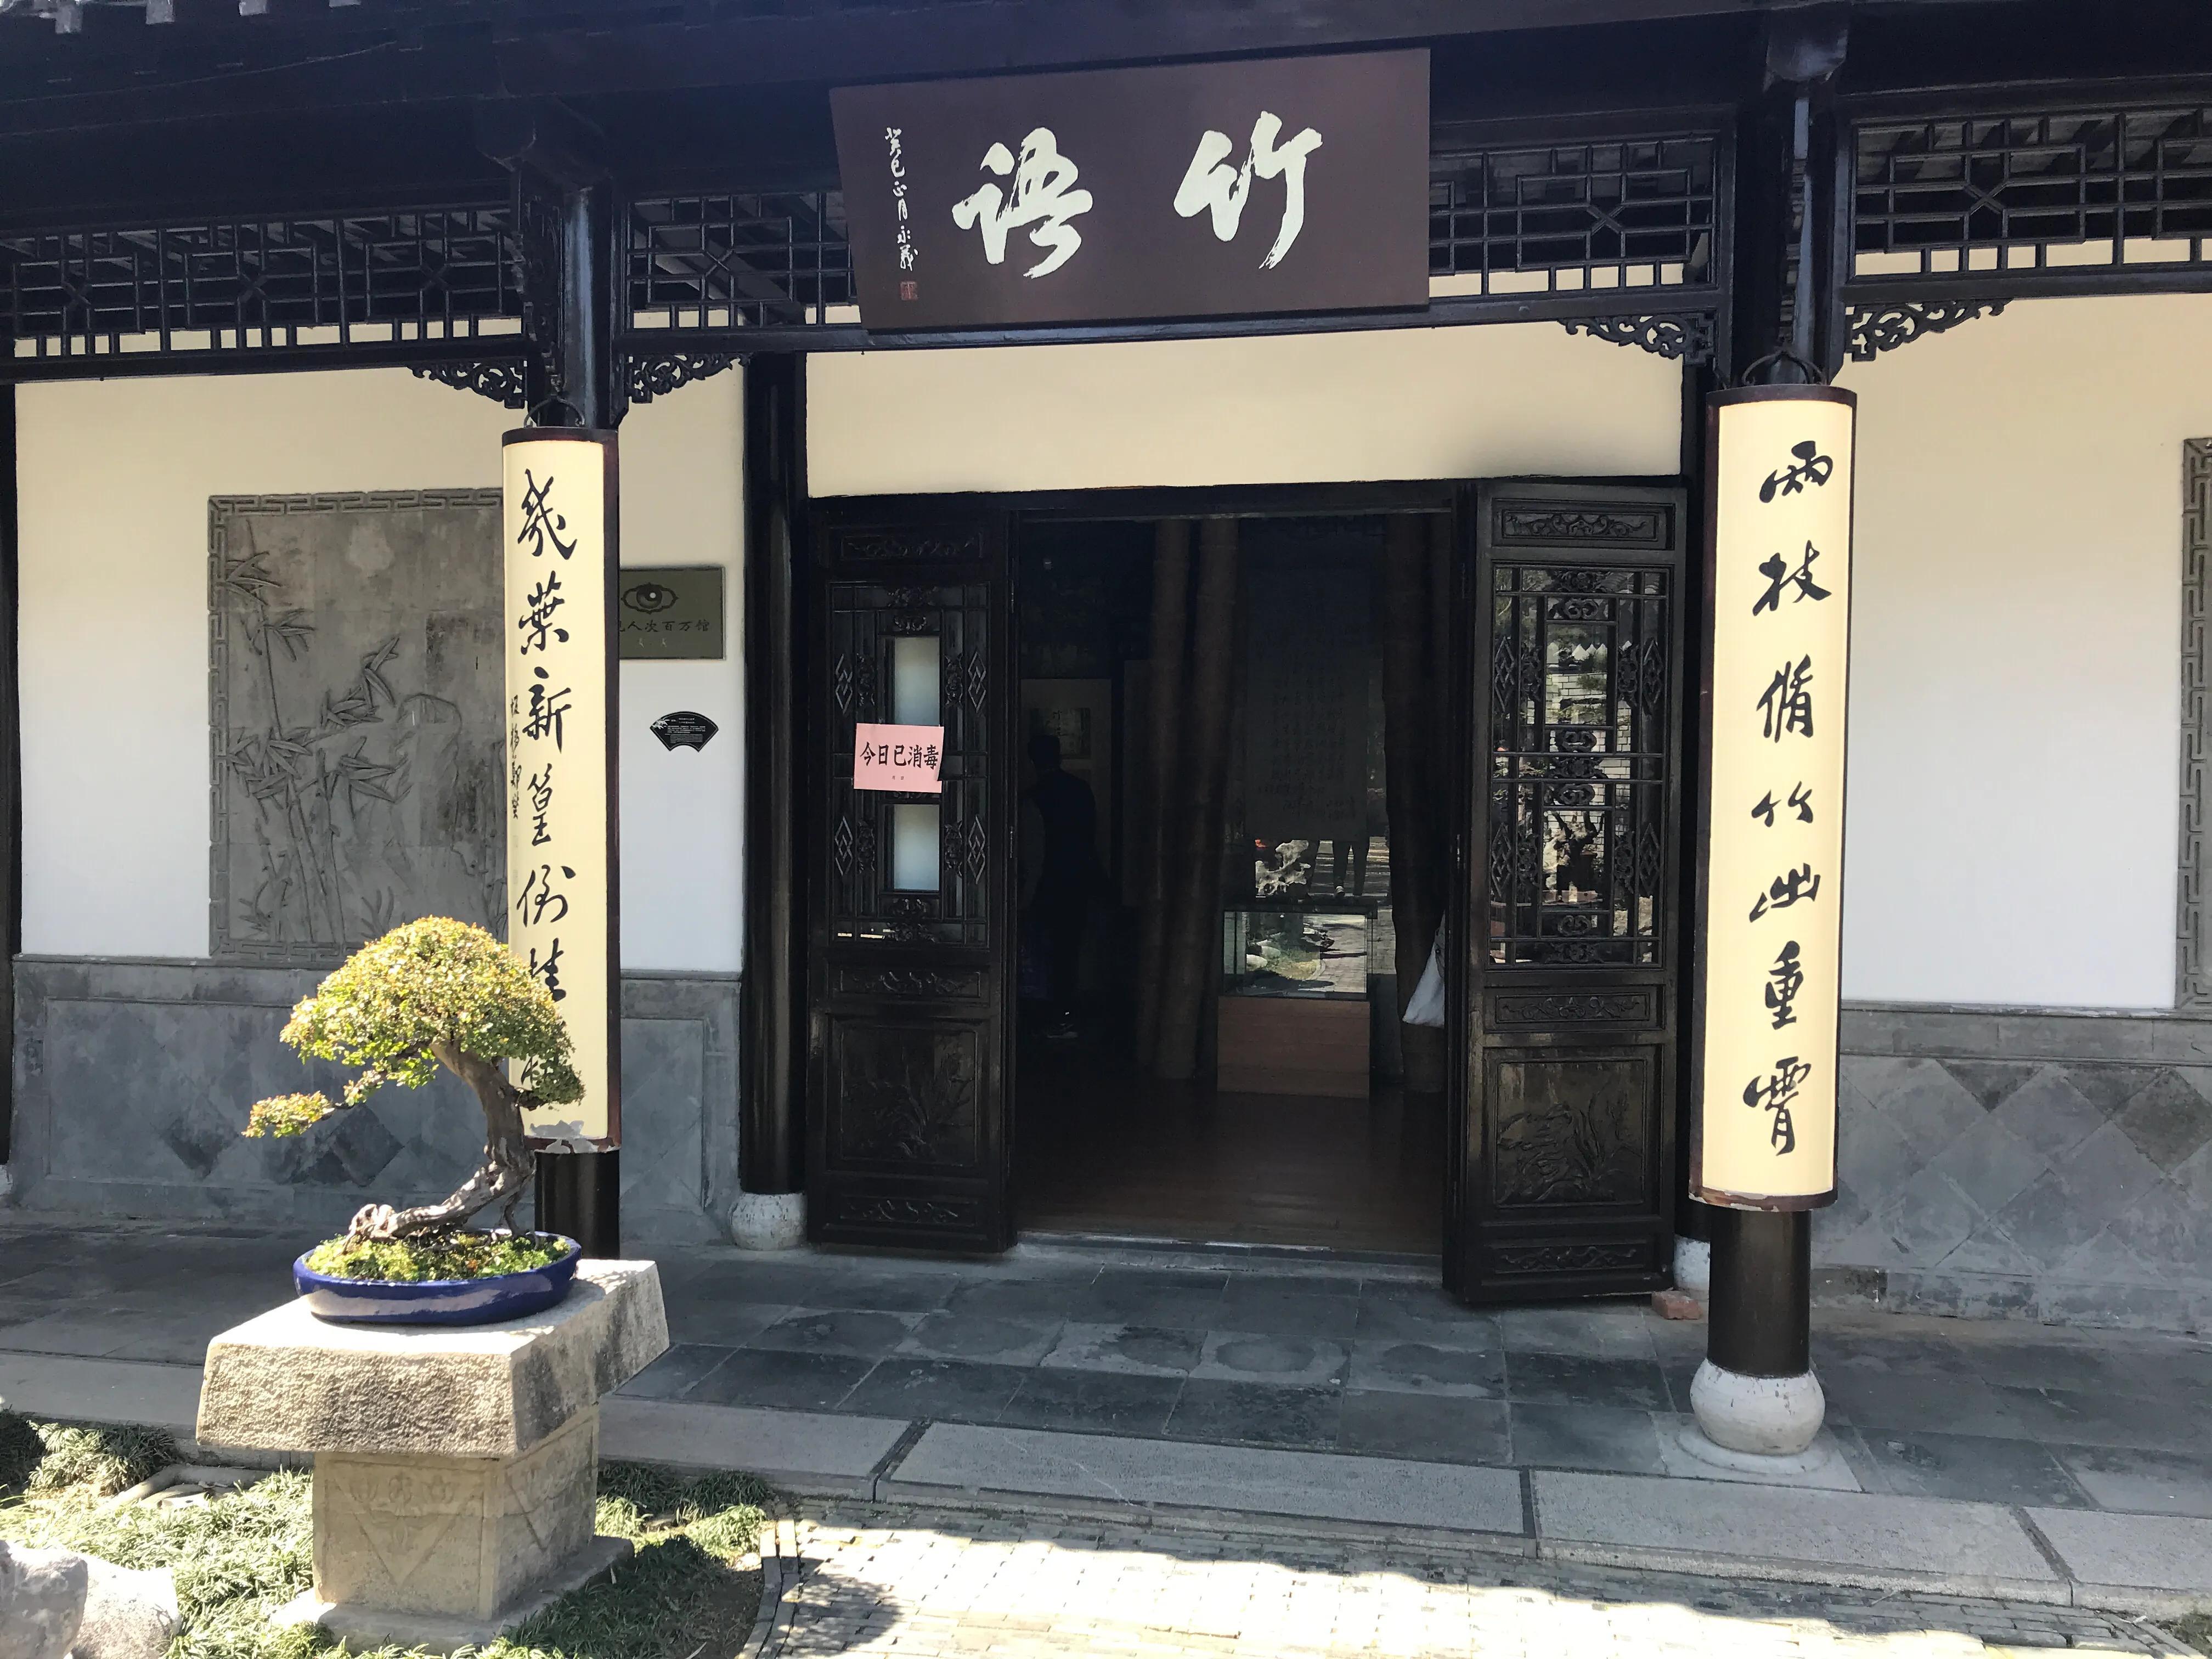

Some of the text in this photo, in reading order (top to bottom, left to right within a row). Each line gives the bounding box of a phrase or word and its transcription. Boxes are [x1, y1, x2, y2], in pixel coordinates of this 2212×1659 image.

[860, 741, 939, 770] 今日已消毒
